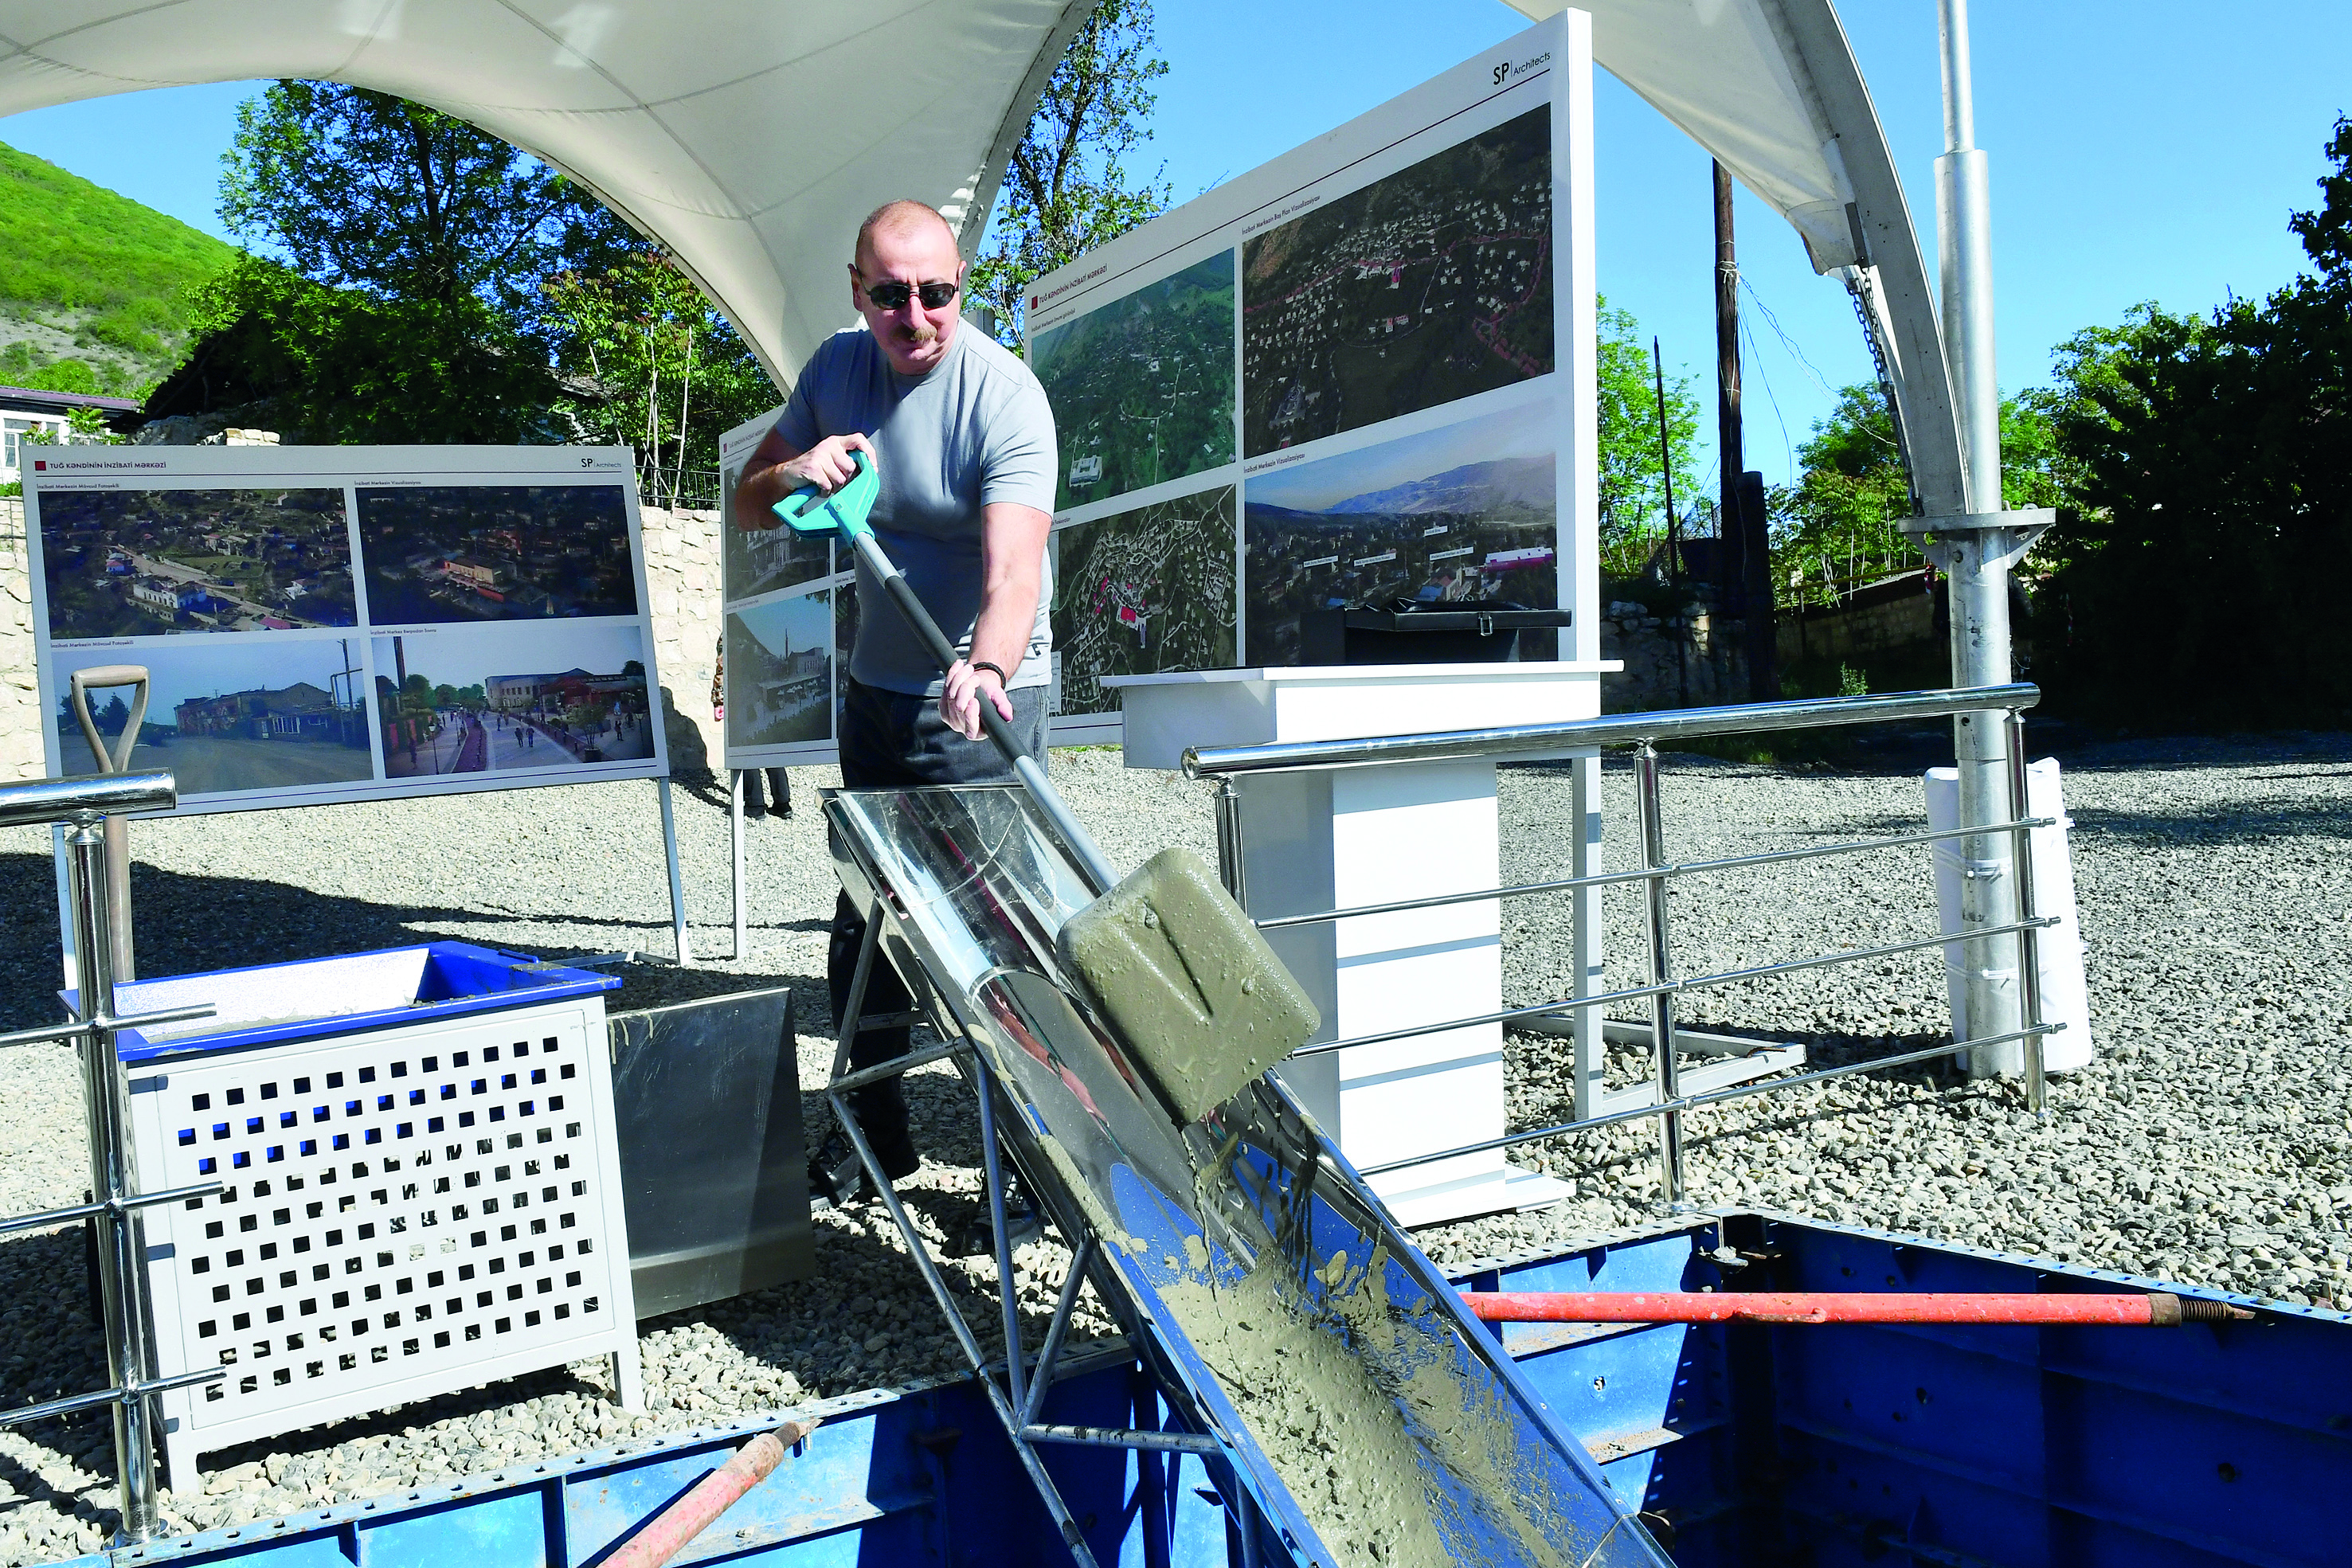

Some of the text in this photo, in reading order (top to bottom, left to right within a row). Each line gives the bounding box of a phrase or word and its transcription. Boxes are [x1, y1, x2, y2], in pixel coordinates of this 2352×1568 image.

[1493, 52, 1551, 85] SP Architects
[581, 458, 593, 468] SP
